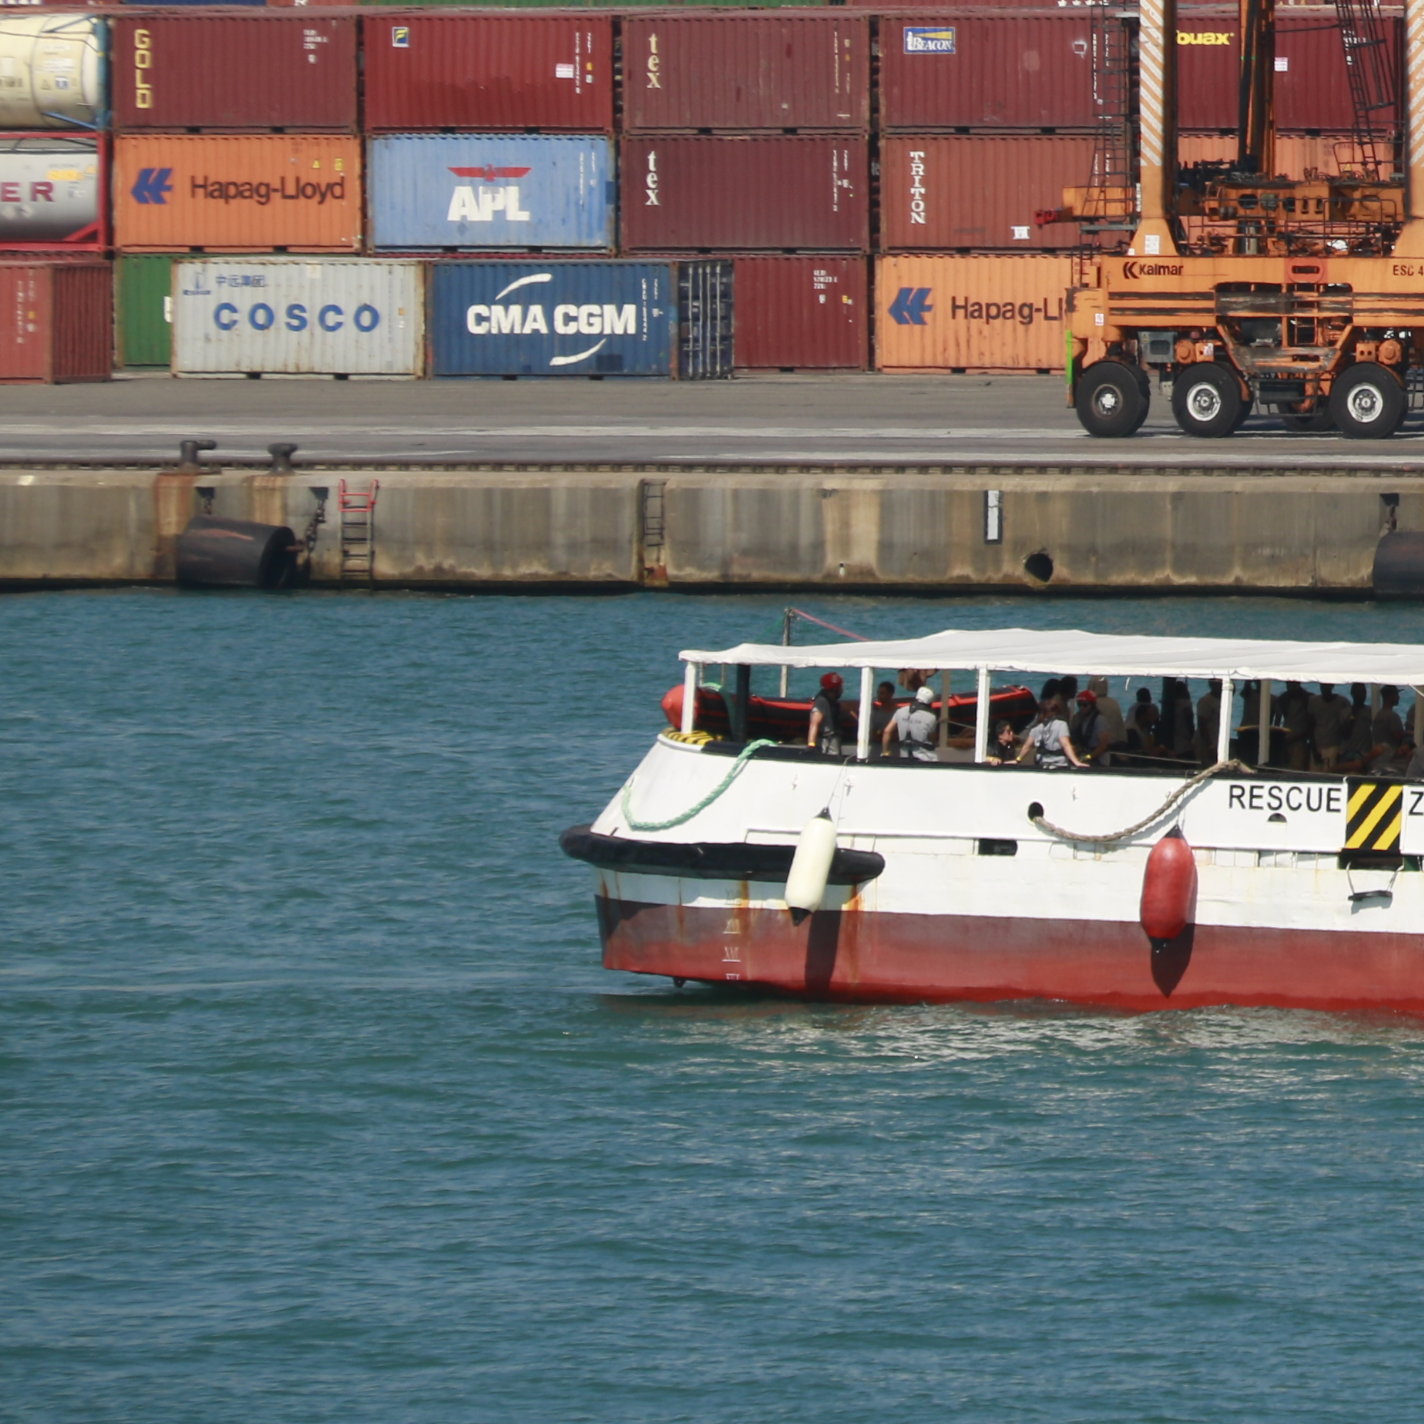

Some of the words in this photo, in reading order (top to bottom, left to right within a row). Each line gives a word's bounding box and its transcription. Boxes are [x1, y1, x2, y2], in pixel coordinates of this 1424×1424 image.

[1176, 29, 1231, 46] ouax
[135, 29, 152, 109] GOLD
[646, 32, 661, 89] tex
[190, 175, 346, 205] Hapag-Lloyd
[645, 149, 661, 206] tex
[910, 151, 927, 224] TRITON
[447, 185, 531, 222] APL
[1138, 262, 1183, 277] Kalmar
[213, 302, 380, 333] COSCO
[467, 303, 549, 335] CMA
[553, 303, 637, 335] CGM
[951, 295, 1066, 325] Hapag-Ll
[1228, 783, 1342, 814] RESCUE
